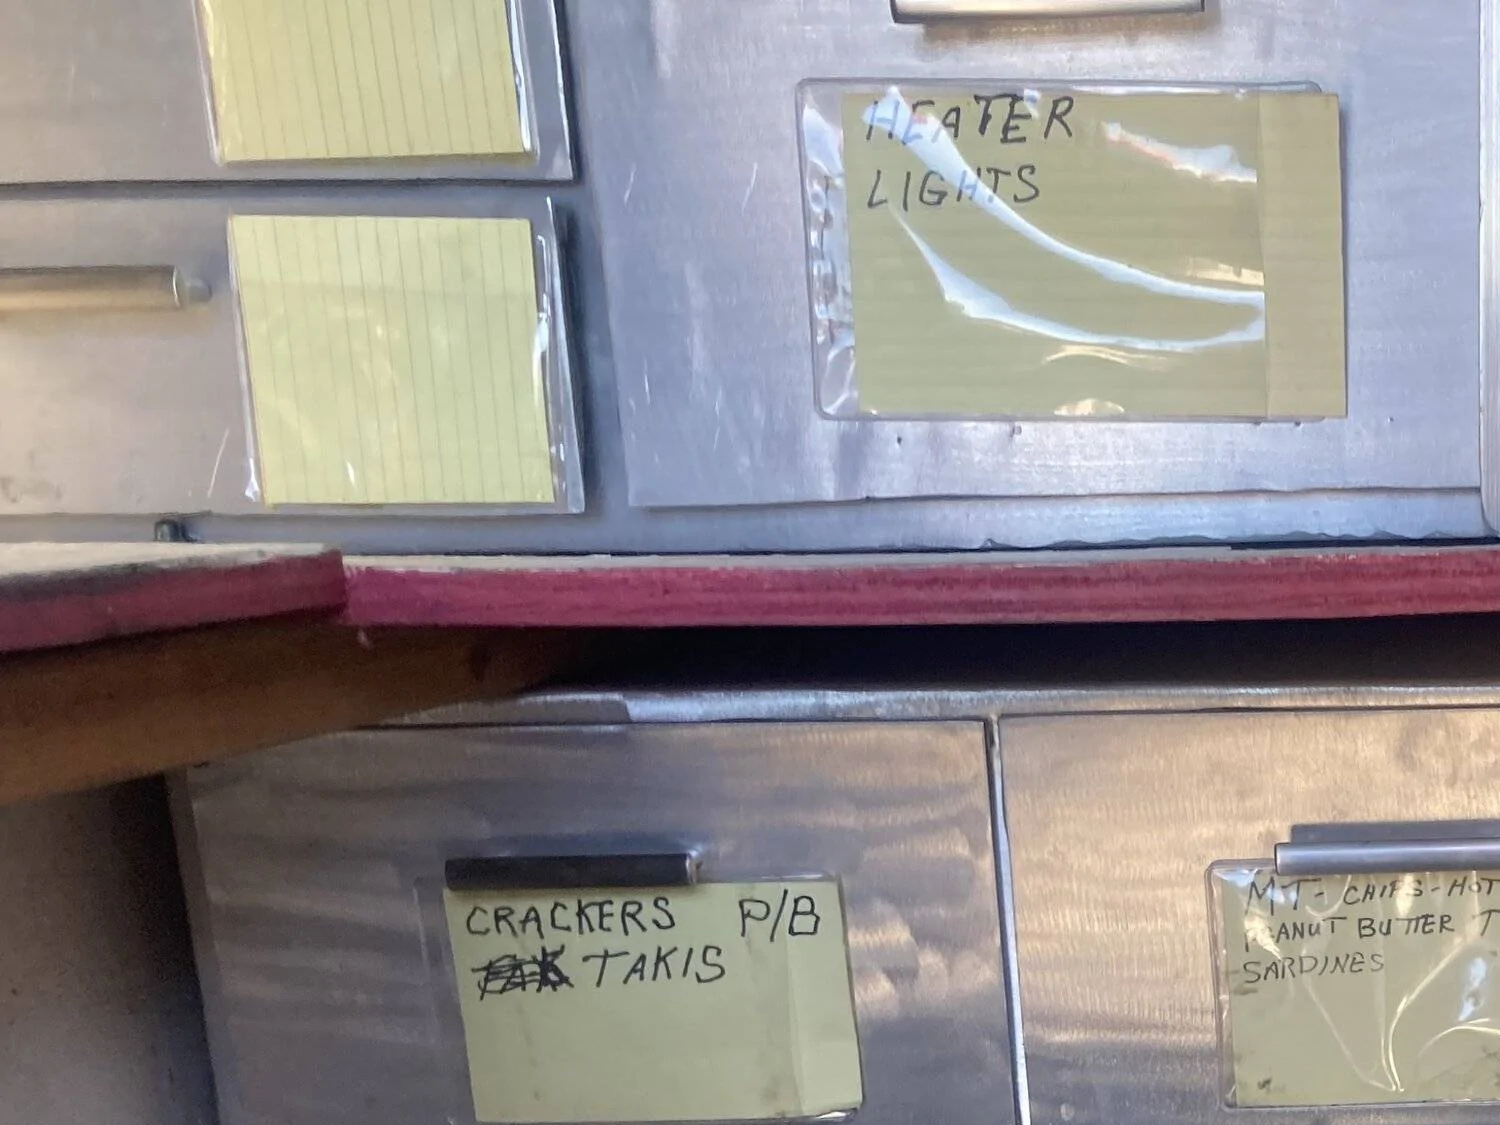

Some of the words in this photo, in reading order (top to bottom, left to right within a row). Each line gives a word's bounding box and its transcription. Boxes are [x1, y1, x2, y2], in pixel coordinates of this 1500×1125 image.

[865, 93, 1075, 146] HEATER
[867, 163, 1041, 213] LIGHTS
[466, 896, 676, 940] CRACKERS
[738, 888, 821, 943] P/B
[1357, 913, 1455, 940] BUTTER
[582, 944, 726, 988] TAKIS
[1243, 951, 1385, 984] SARDINES
